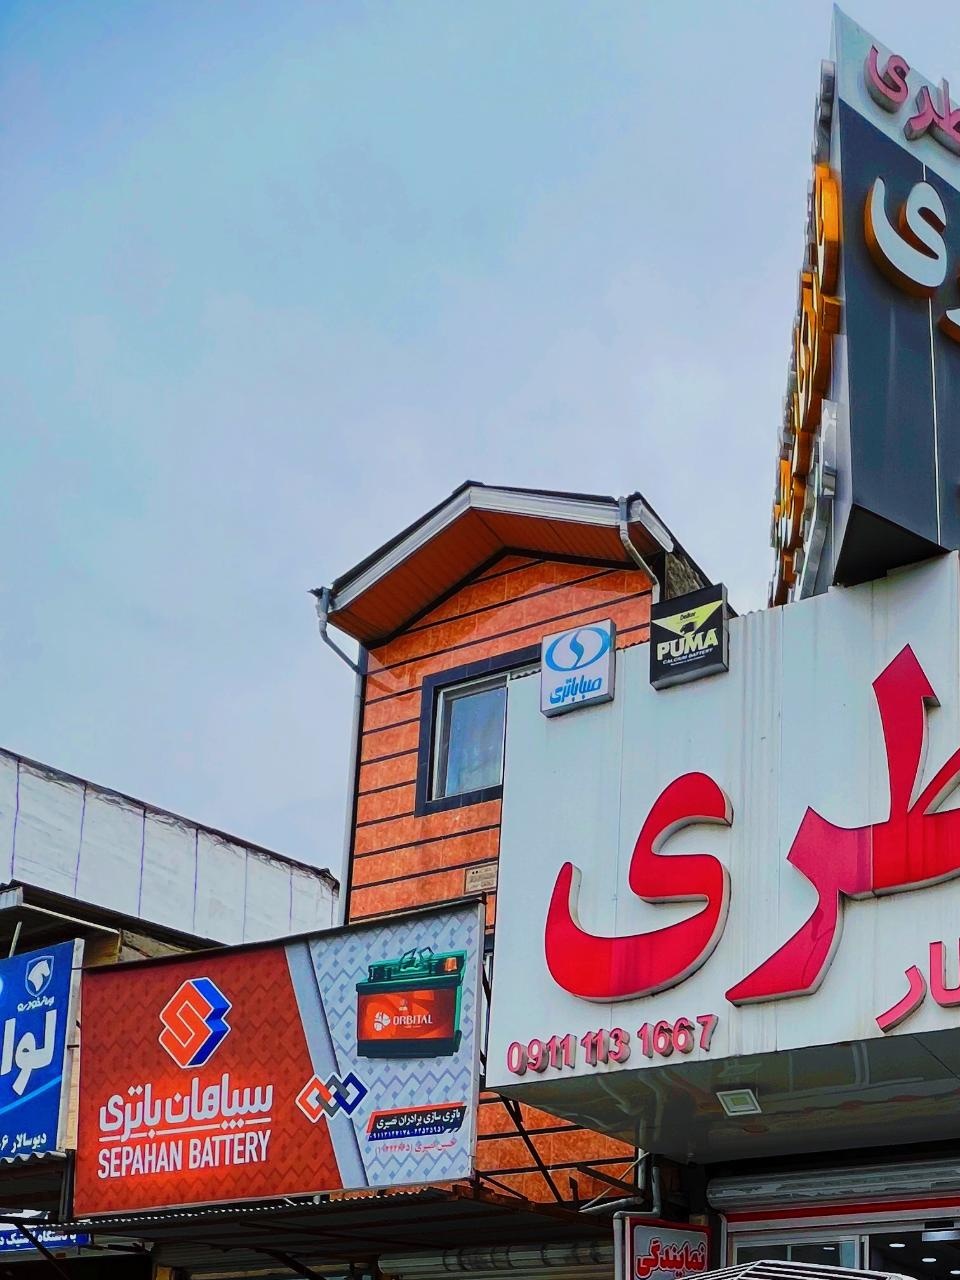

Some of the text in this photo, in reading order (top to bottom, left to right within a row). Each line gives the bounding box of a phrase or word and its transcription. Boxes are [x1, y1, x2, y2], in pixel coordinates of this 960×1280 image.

[657, 627, 719, 661] PUMA
[393, 1014, 433, 1026] ORBITAL
[507, 1013, 719, 1076] 0911 113 1667
[98, 1073, 274, 1142] سپاهان باتری
[97, 1129, 272, 1179] SEPAHAN BATTERY
[636, 1238, 707, 1279] نمایندگی
